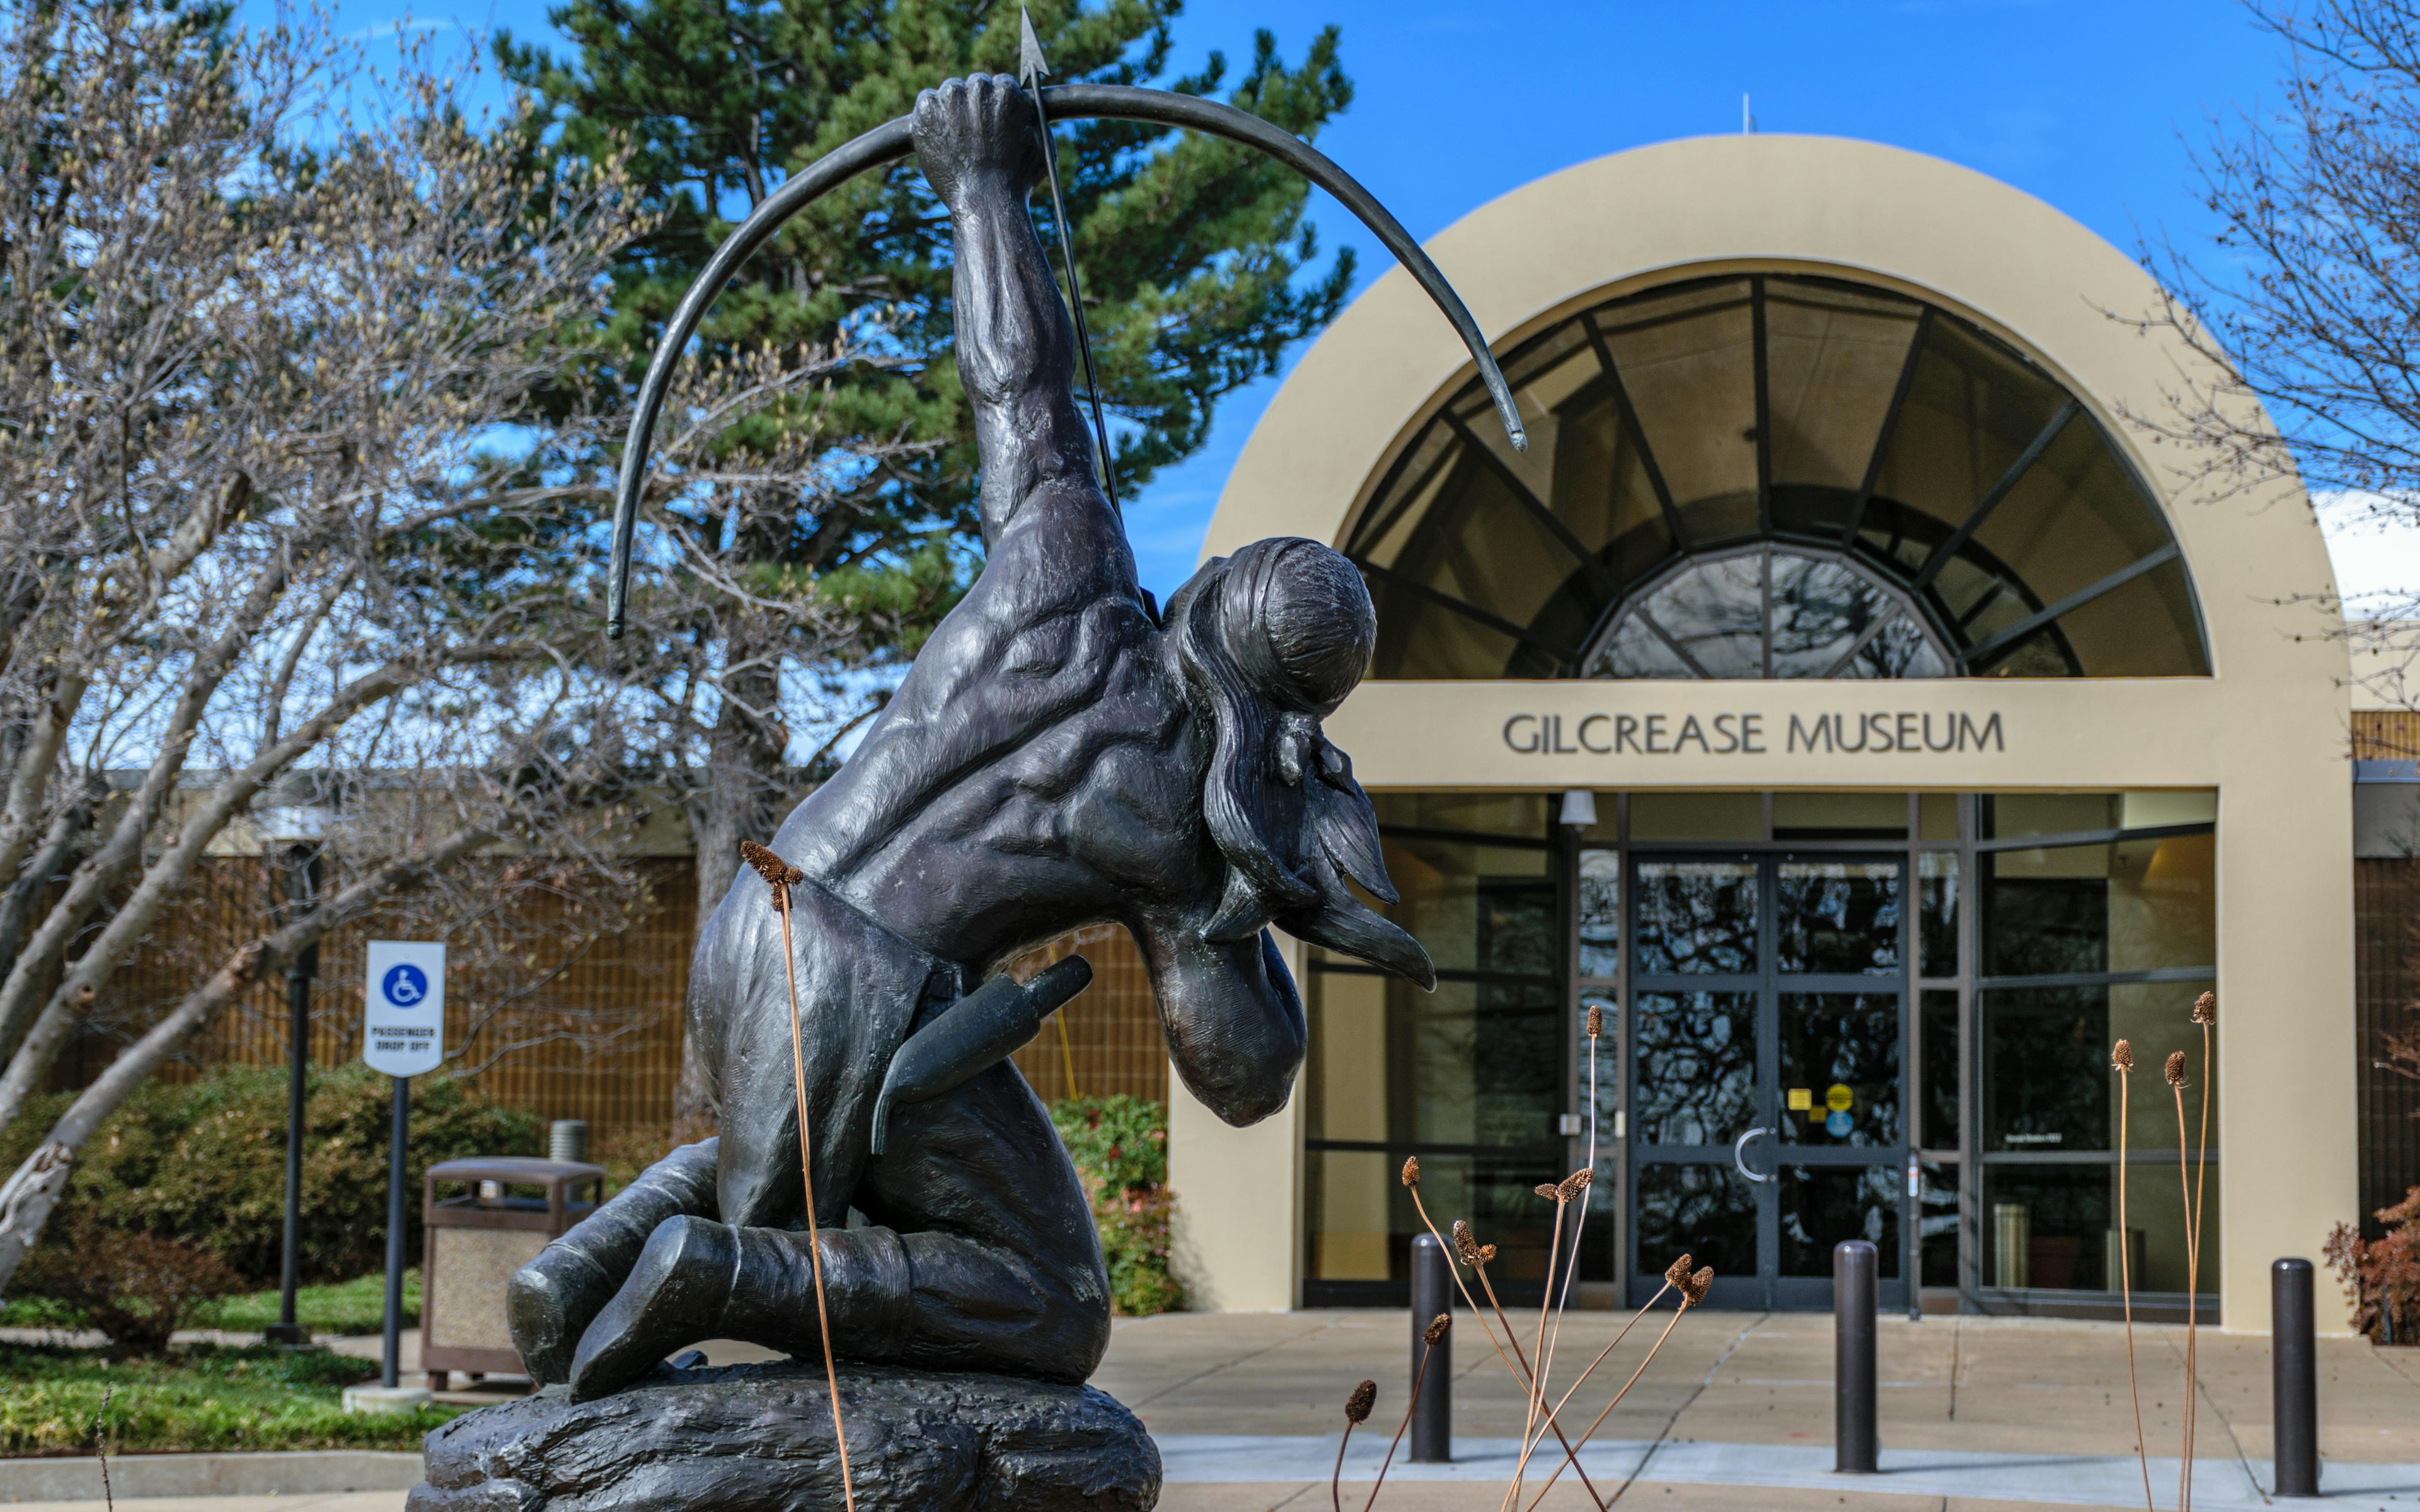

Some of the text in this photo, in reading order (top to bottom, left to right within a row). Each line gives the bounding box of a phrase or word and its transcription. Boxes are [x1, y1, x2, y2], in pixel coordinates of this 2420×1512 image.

[1503, 712, 2005, 754] GILCREASE MUSEUM
[372, 1027, 434, 1037] PASSENGER
[376, 1041, 430, 1051] DROP OFF
